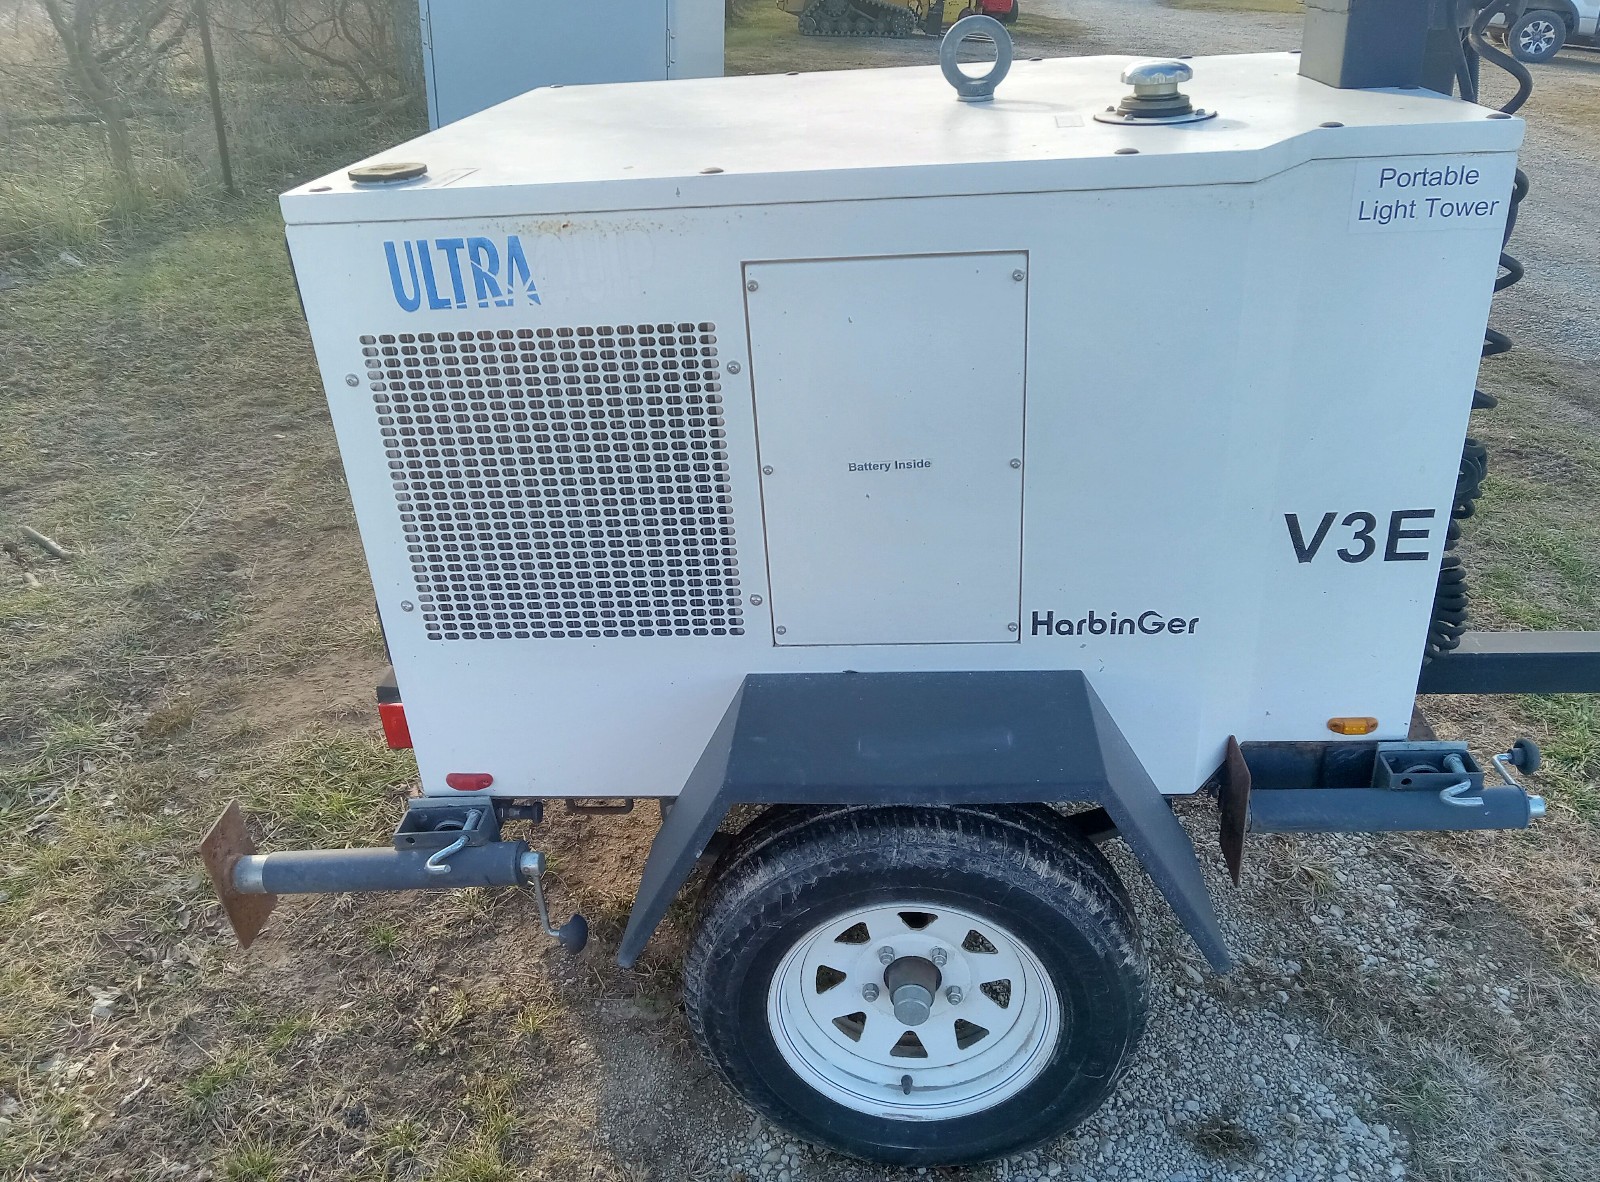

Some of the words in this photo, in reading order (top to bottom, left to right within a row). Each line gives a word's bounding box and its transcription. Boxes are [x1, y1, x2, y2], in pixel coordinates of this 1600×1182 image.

[1379, 165, 1479, 188] Portable
[1358, 200, 1416, 225] Light
[1425, 198, 1499, 218] Tower
[383, 235, 541, 312] ULTRA
[848, 461, 891, 472] Battery
[895, 459, 931, 469] Inside
[1284, 508, 1435, 563] V3E
[1031, 610, 1199, 636] HarbinGer
